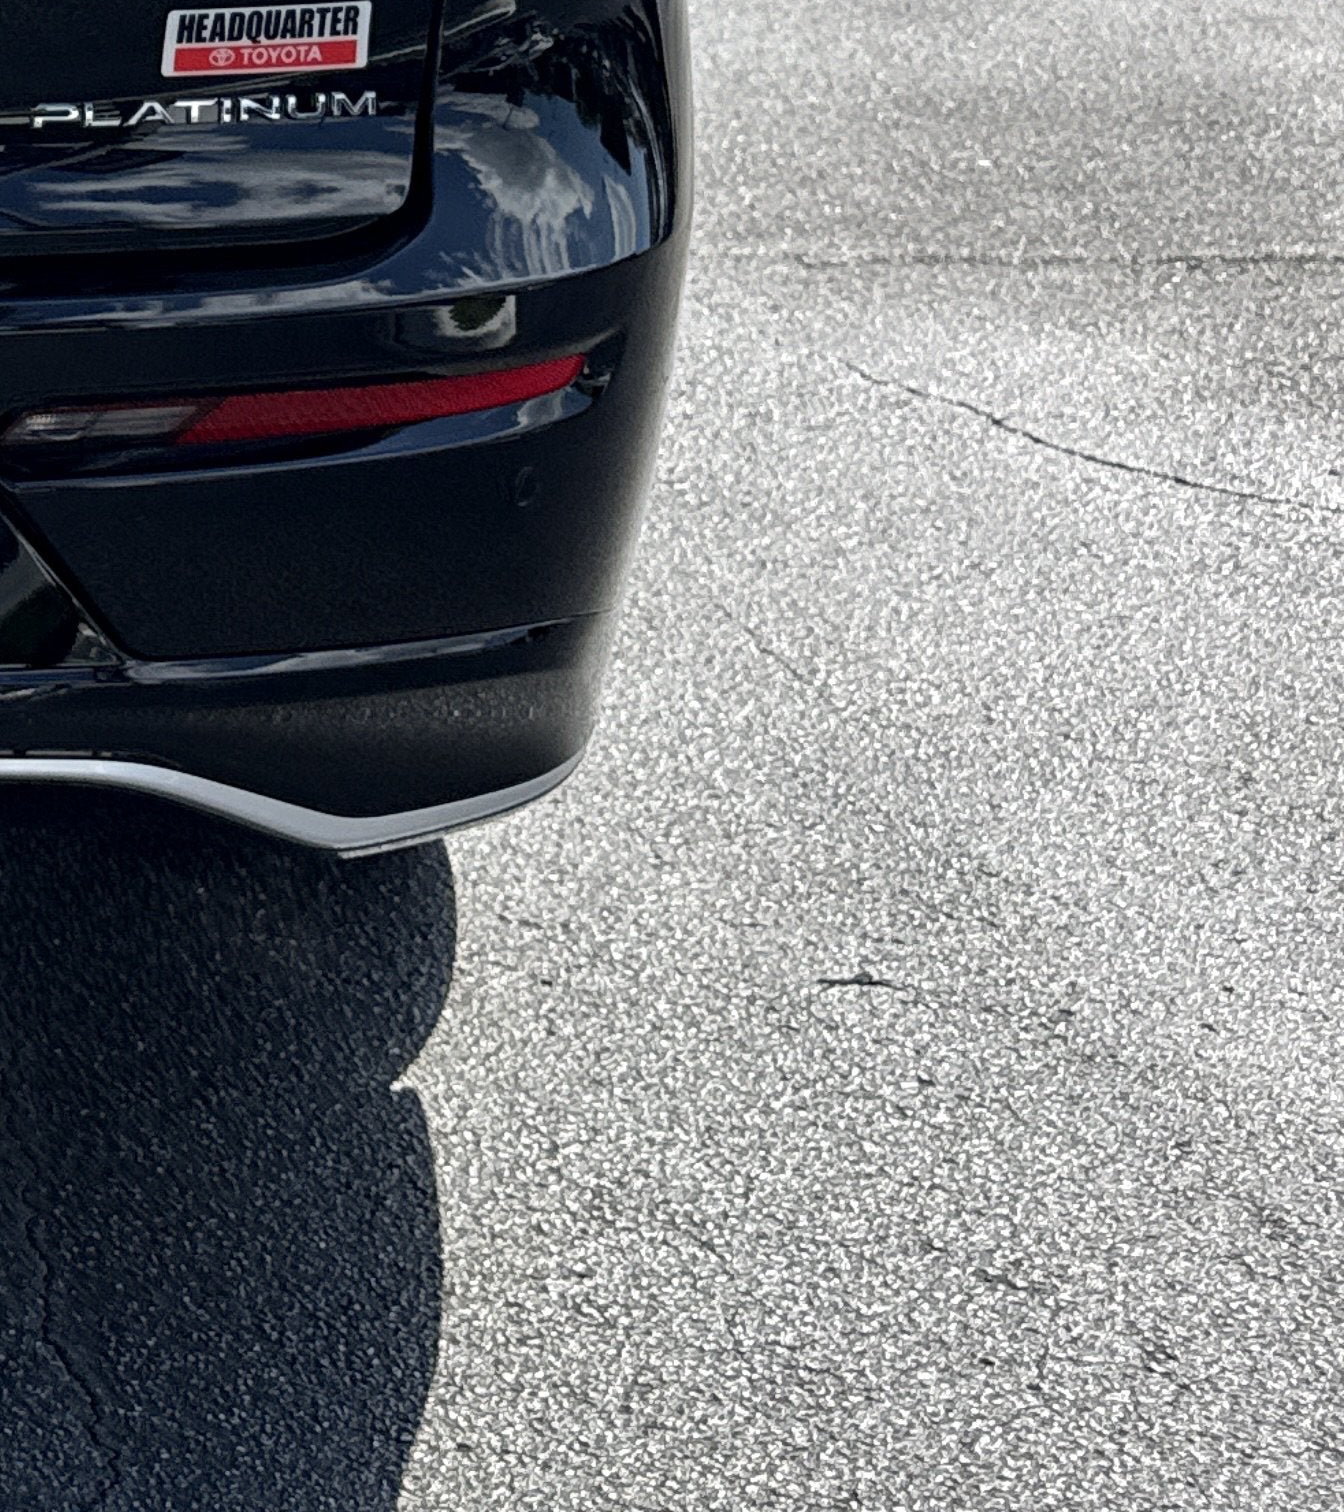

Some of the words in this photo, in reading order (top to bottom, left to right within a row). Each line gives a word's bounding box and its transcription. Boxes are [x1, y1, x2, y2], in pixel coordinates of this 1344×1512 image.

[175, 5, 360, 45] HEADQUARTER
[240, 45, 323, 65] TOYOTA
[30, 90, 378, 129] PLATINUM
